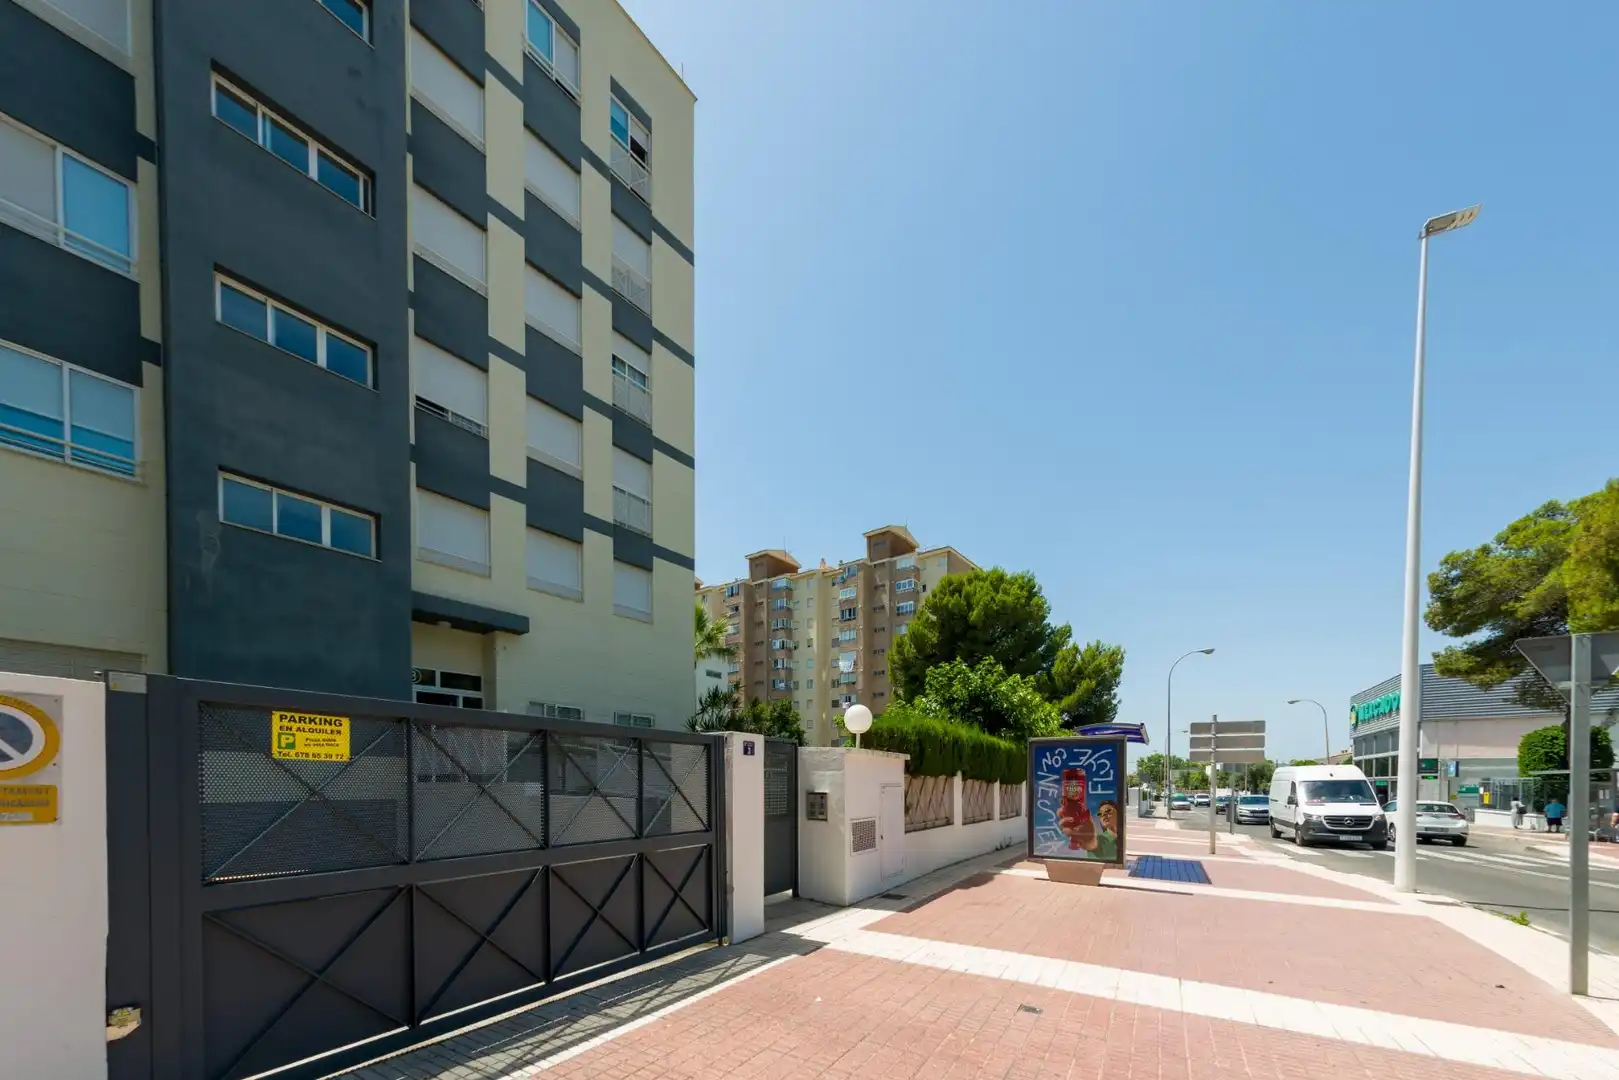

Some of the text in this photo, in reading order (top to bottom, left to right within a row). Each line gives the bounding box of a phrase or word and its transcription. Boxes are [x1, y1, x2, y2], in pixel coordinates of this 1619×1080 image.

[279, 714, 343, 727] PARKING
[296, 727, 342, 736] ALQUILER
[1042, 748, 1067, 772] CON
